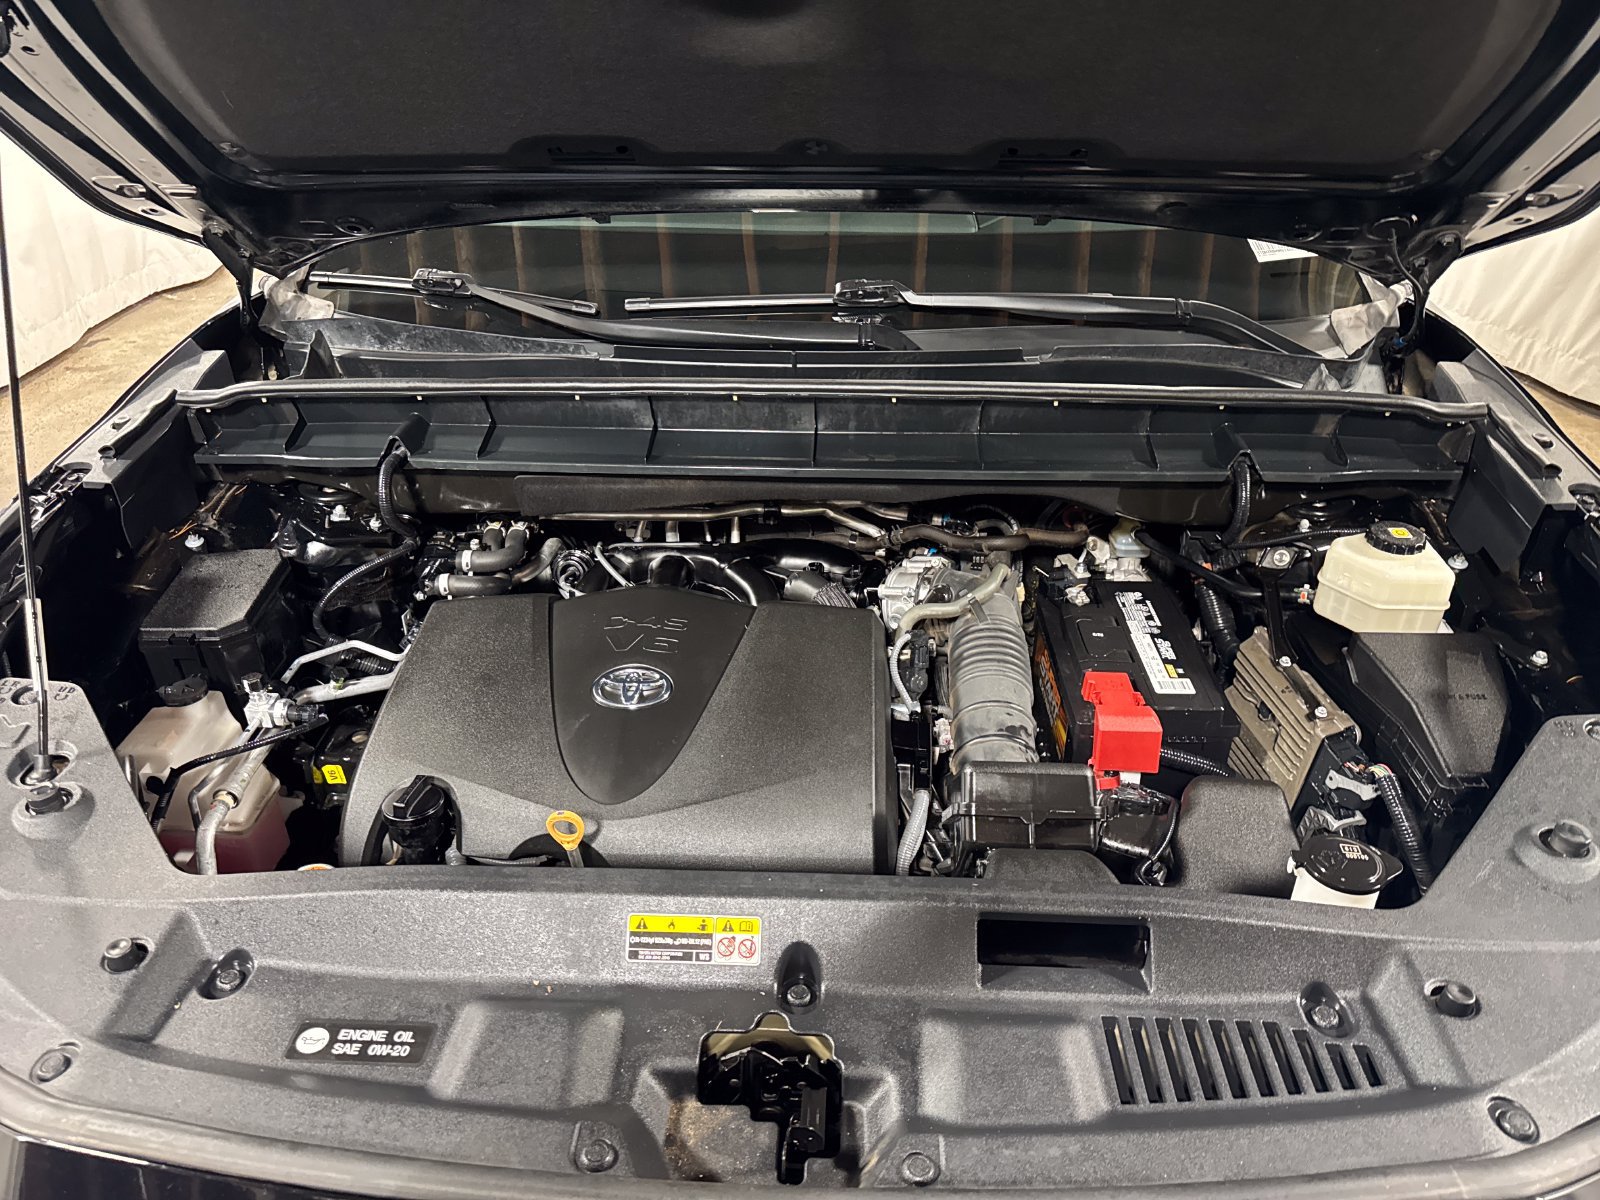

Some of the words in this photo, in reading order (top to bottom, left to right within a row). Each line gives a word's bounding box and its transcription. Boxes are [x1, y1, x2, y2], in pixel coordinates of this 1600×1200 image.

[605, 633, 679, 653] V6
[327, 769, 338, 780] V6
[337, 1028, 389, 1042] ENGINE
[393, 1031, 415, 1043] OIL
[331, 1043, 363, 1055] SAE
[367, 1044, 411, 1057] 0W-20
